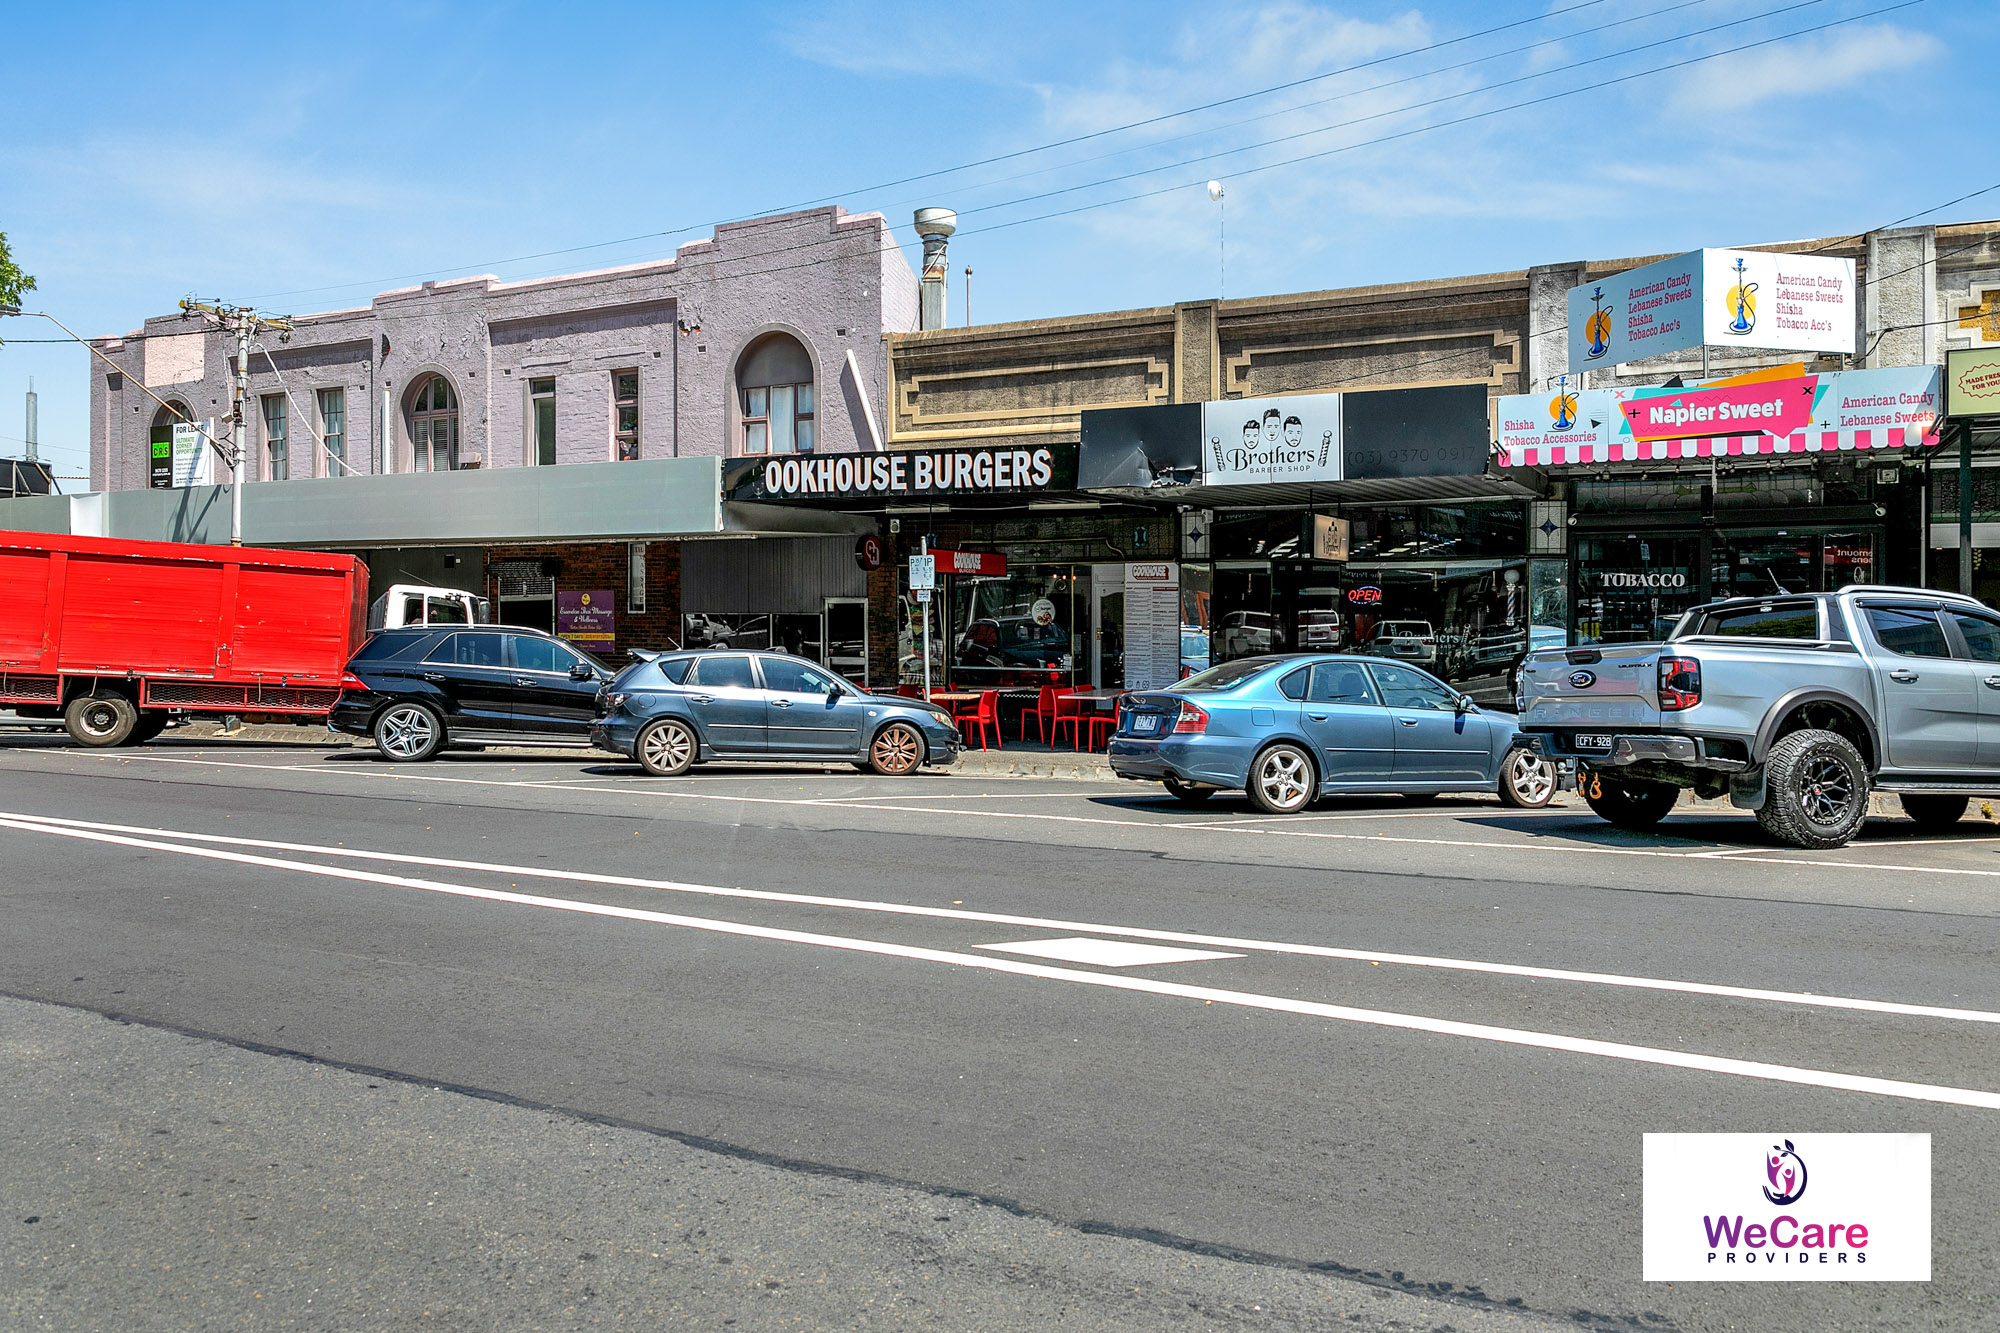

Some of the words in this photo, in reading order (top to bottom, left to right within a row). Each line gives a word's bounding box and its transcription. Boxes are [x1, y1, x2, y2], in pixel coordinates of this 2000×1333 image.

[1628, 282, 1665, 300] American
[1666, 272, 1691, 288] Candy
[1776, 272, 1816, 287] American
[1817, 276, 1843, 291] Candy
[1628, 296, 1663, 314] Lebanese
[1664, 287, 1692, 305] Sweets
[1776, 288, 1813, 302] Lebanese
[1815, 290, 1843, 303] Sweets
[1776, 302, 1803, 315] Shisha
[1628, 313, 1653, 328] Shisha
[1776, 316, 1809, 329] Tobacco
[1810, 319, 1832, 331] Acc's
[1628, 326, 1658, 342] Tobacco
[1660, 319, 1680, 334] Acc's
[1965, 376, 1984, 385] MADE
[1841, 394, 1897, 408] American
[1899, 391, 1935, 406] Candy
[1649, 402, 1716, 427] Napier
[1718, 398, 1783, 420] Sweet
[1840, 414, 1892, 427] Lebanese
[1894, 410, 1935, 423] Sweets
[176, 426, 187, 434] FOR
[1504, 419, 1535, 431] Shisha
[1504, 435, 1541, 446] Tobacco
[1542, 431, 1597, 444] Accessories
[153, 447, 168, 456] CRS
[1226, 445, 1315, 471] Brothers
[1347, 450, 1382, 466] (03)
[1388, 448, 1430, 462] 9370
[1437, 446, 1476, 461] 0917
[765, 456, 907, 494] OOKHOUSE
[914, 449, 1052, 490] BURGERS
[1600, 573, 1685, 587] TOBACCO
[1348, 589, 1382, 602] OPEN
